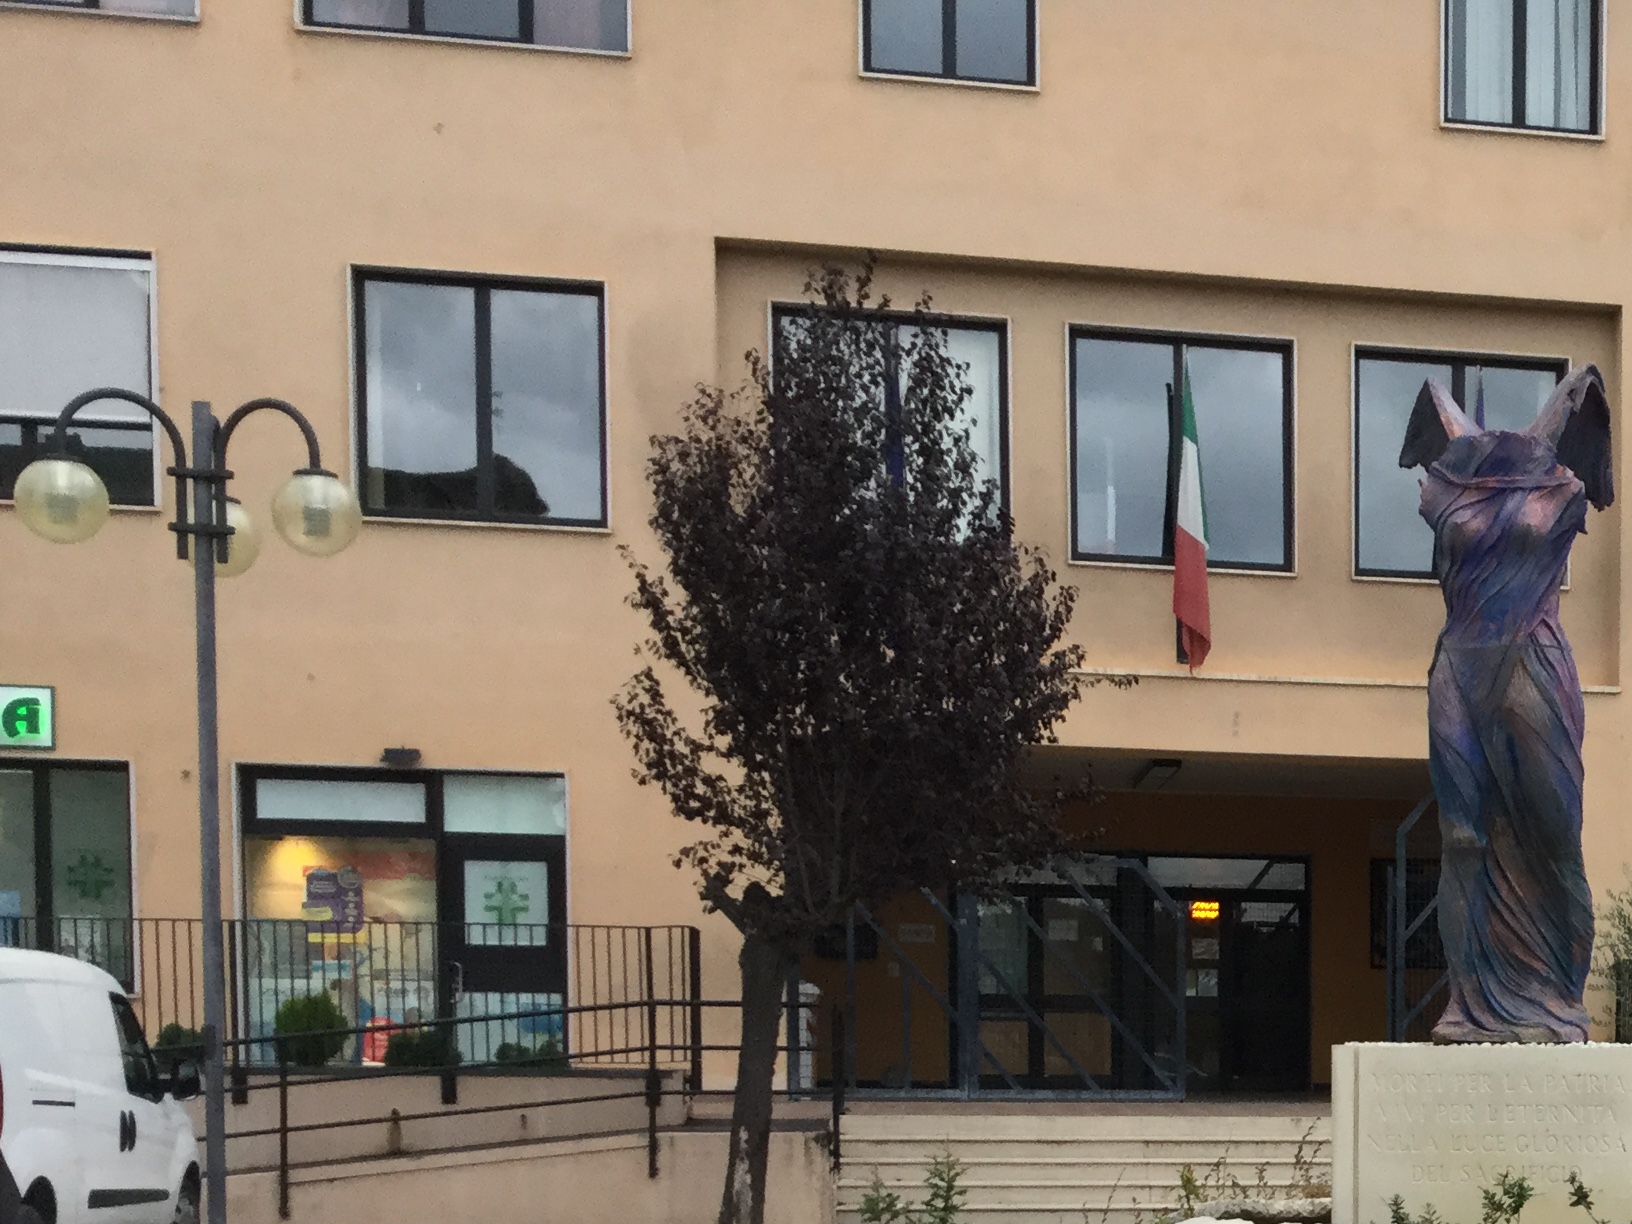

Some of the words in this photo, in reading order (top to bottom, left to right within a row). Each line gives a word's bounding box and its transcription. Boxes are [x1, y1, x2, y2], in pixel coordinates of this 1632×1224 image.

[1371, 1072, 1445, 1093] MORTI
[1454, 1073, 1493, 1093] PER
[1504, 1073, 1533, 1094] LA
[1544, 1073, 1626, 1095] PATRIA
[1377, 1103, 1425, 1123] VIVI
[1436, 1103, 1476, 1123] PER
[1367, 1133, 1440, 1153] NELLA
[1516, 1133, 1627, 1154] GLORIOSA
[1411, 1164, 1450, 1184] DEL
